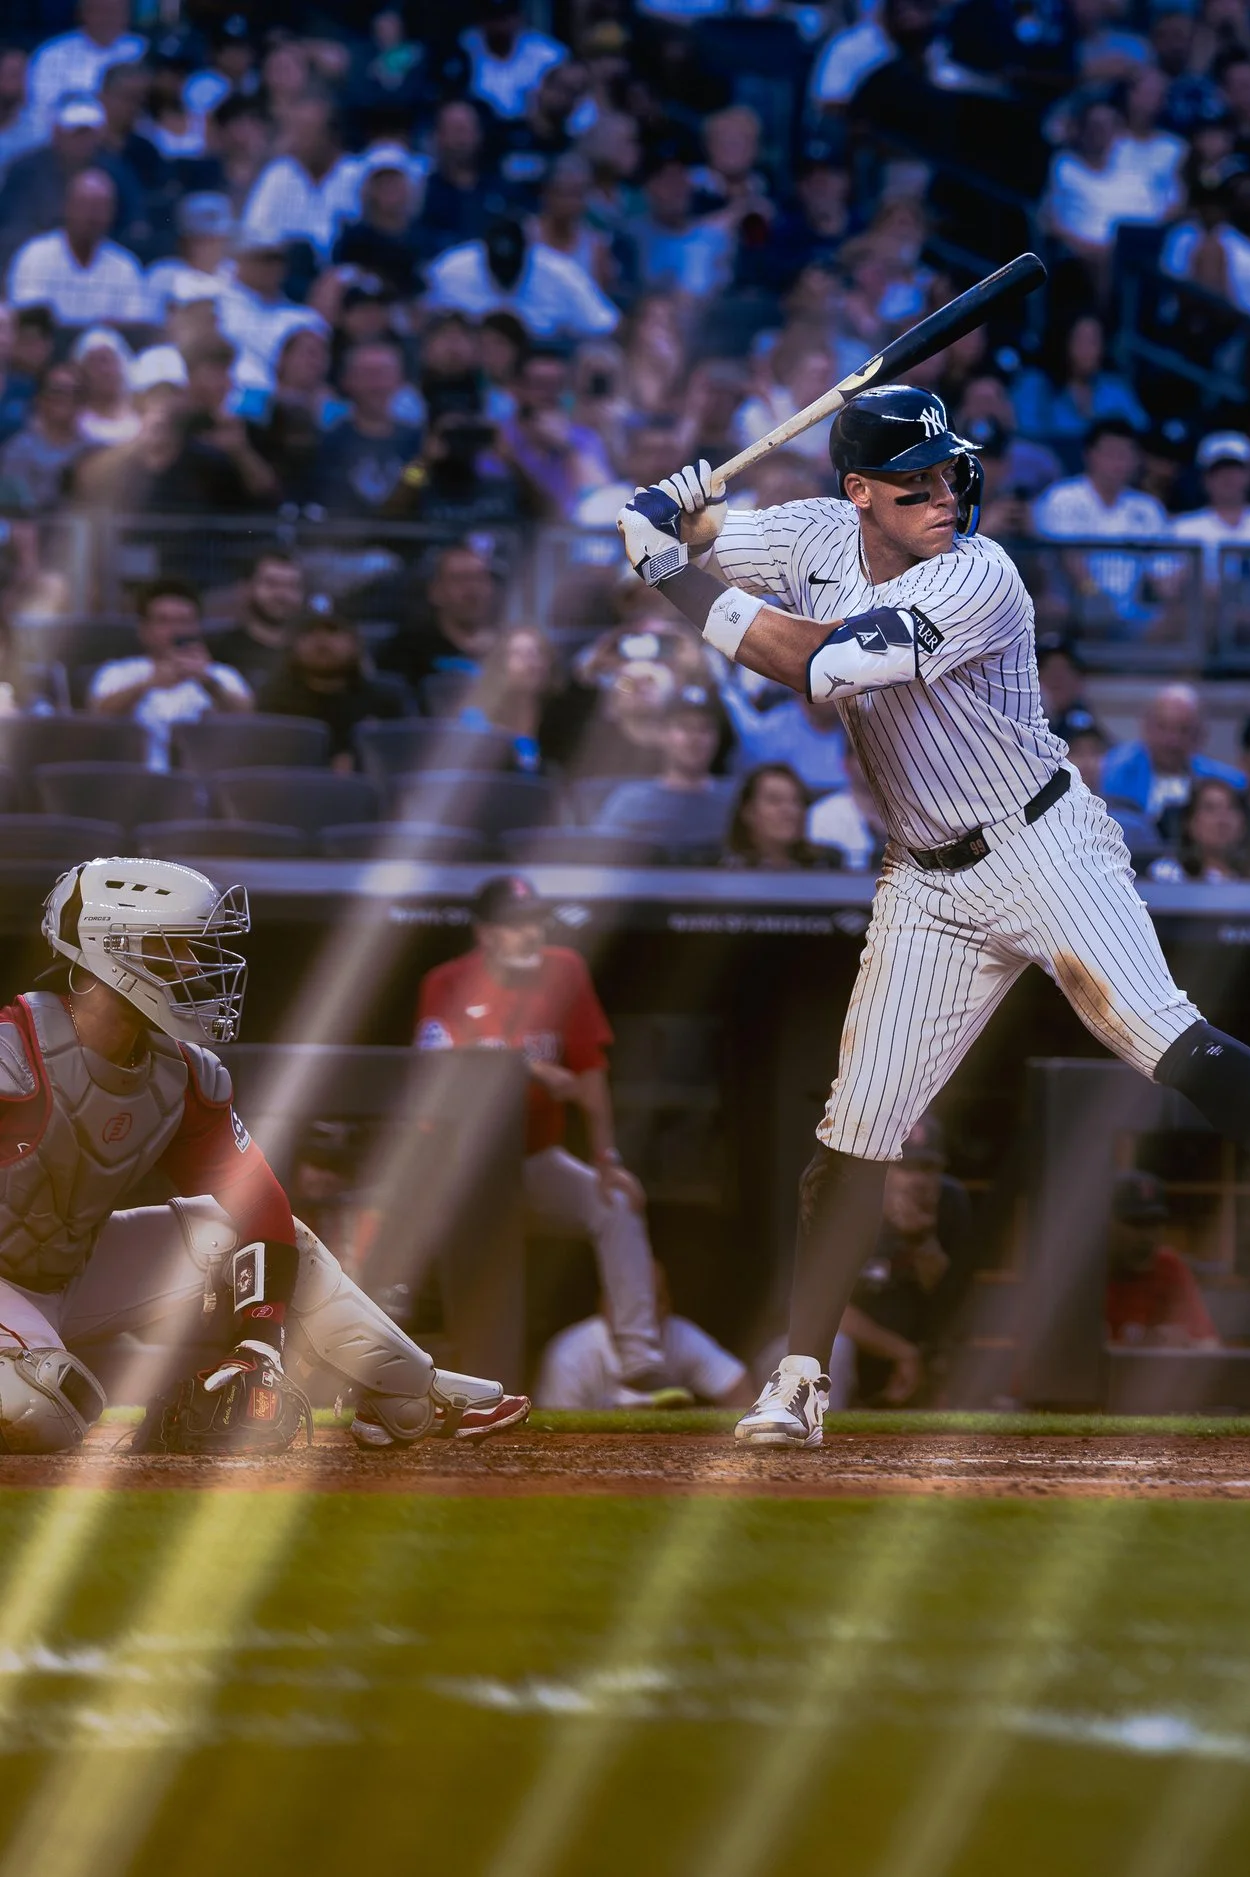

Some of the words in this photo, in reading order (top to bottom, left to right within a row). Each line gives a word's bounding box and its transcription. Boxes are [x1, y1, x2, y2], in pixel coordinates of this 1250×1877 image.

[920, 406, 946, 438] NY
[729, 611, 741, 624] 99
[970, 838, 986, 855] 99
